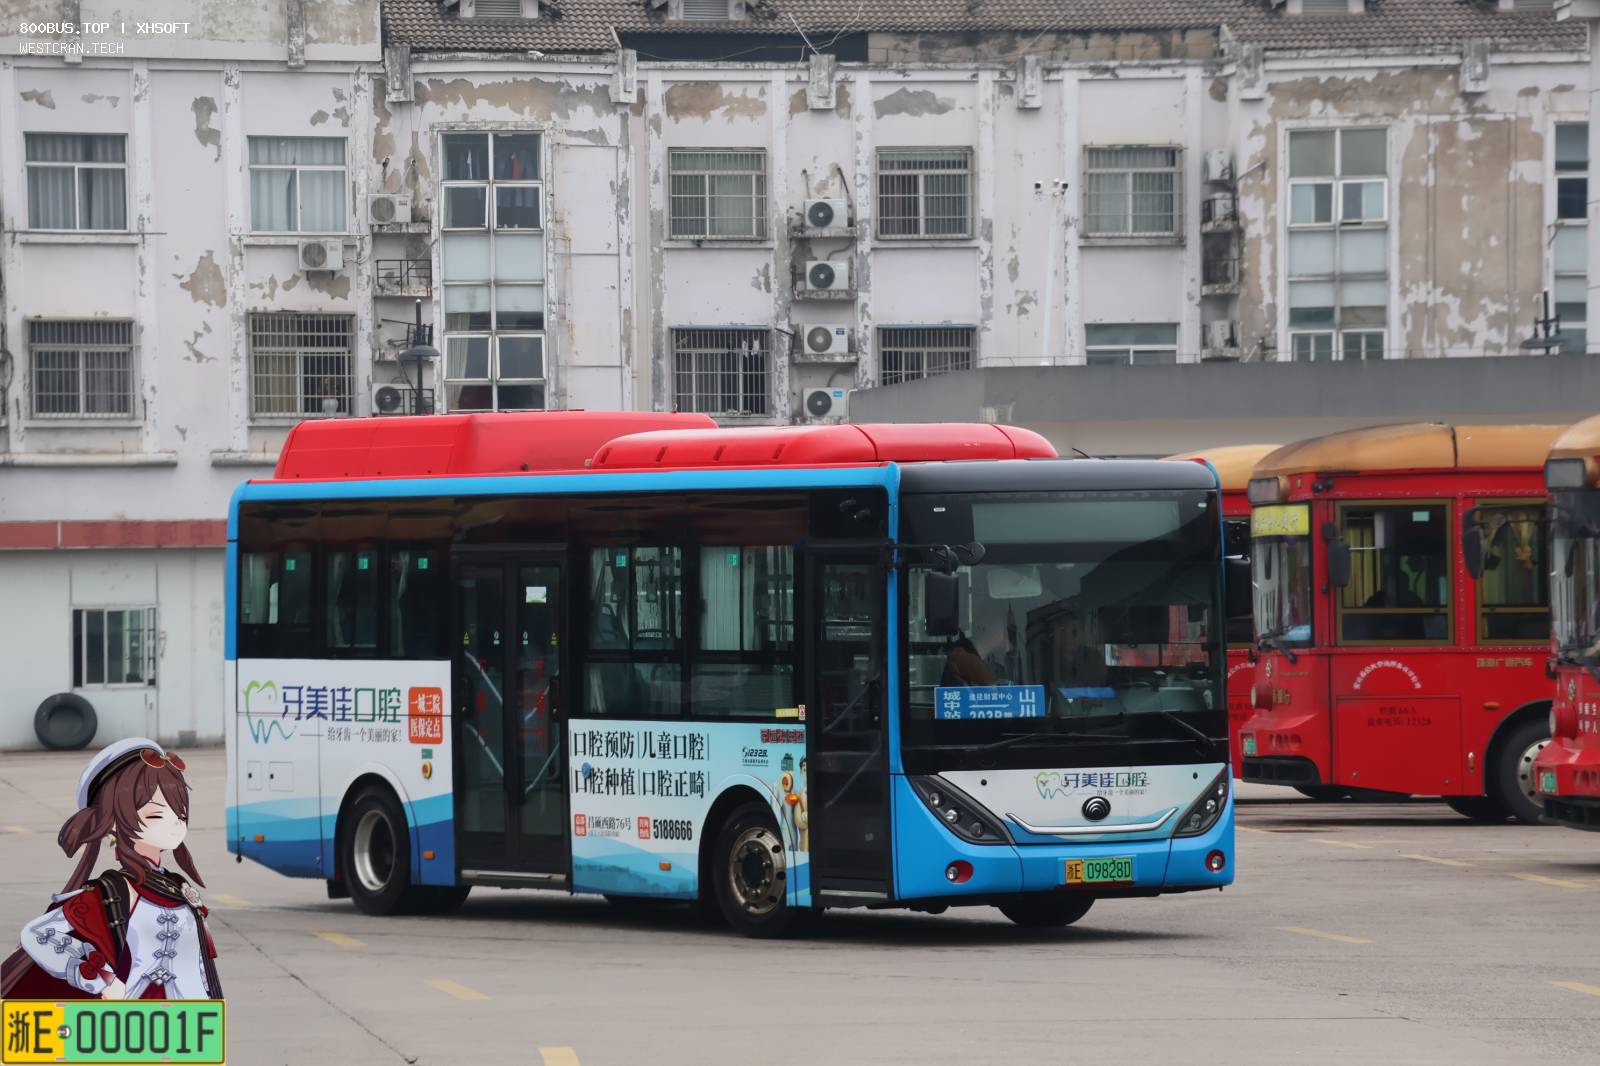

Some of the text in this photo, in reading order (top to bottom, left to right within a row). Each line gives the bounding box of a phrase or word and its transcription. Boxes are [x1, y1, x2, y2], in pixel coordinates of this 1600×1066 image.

[282, 685, 401, 723] 牙美佳口腔
[1019, 688, 1037, 718] 山川
[574, 730, 635, 759] 口腔预防
[642, 731, 705, 760] 儿童口腔
[574, 768, 635, 796] 口腔种植
[642, 769, 705, 799] 口腔正畸
[1062, 772, 1148, 788] 牙美佳口腔
[653, 819, 692, 840] 5188666
[1087, 861, 1131, 880] 09828D
